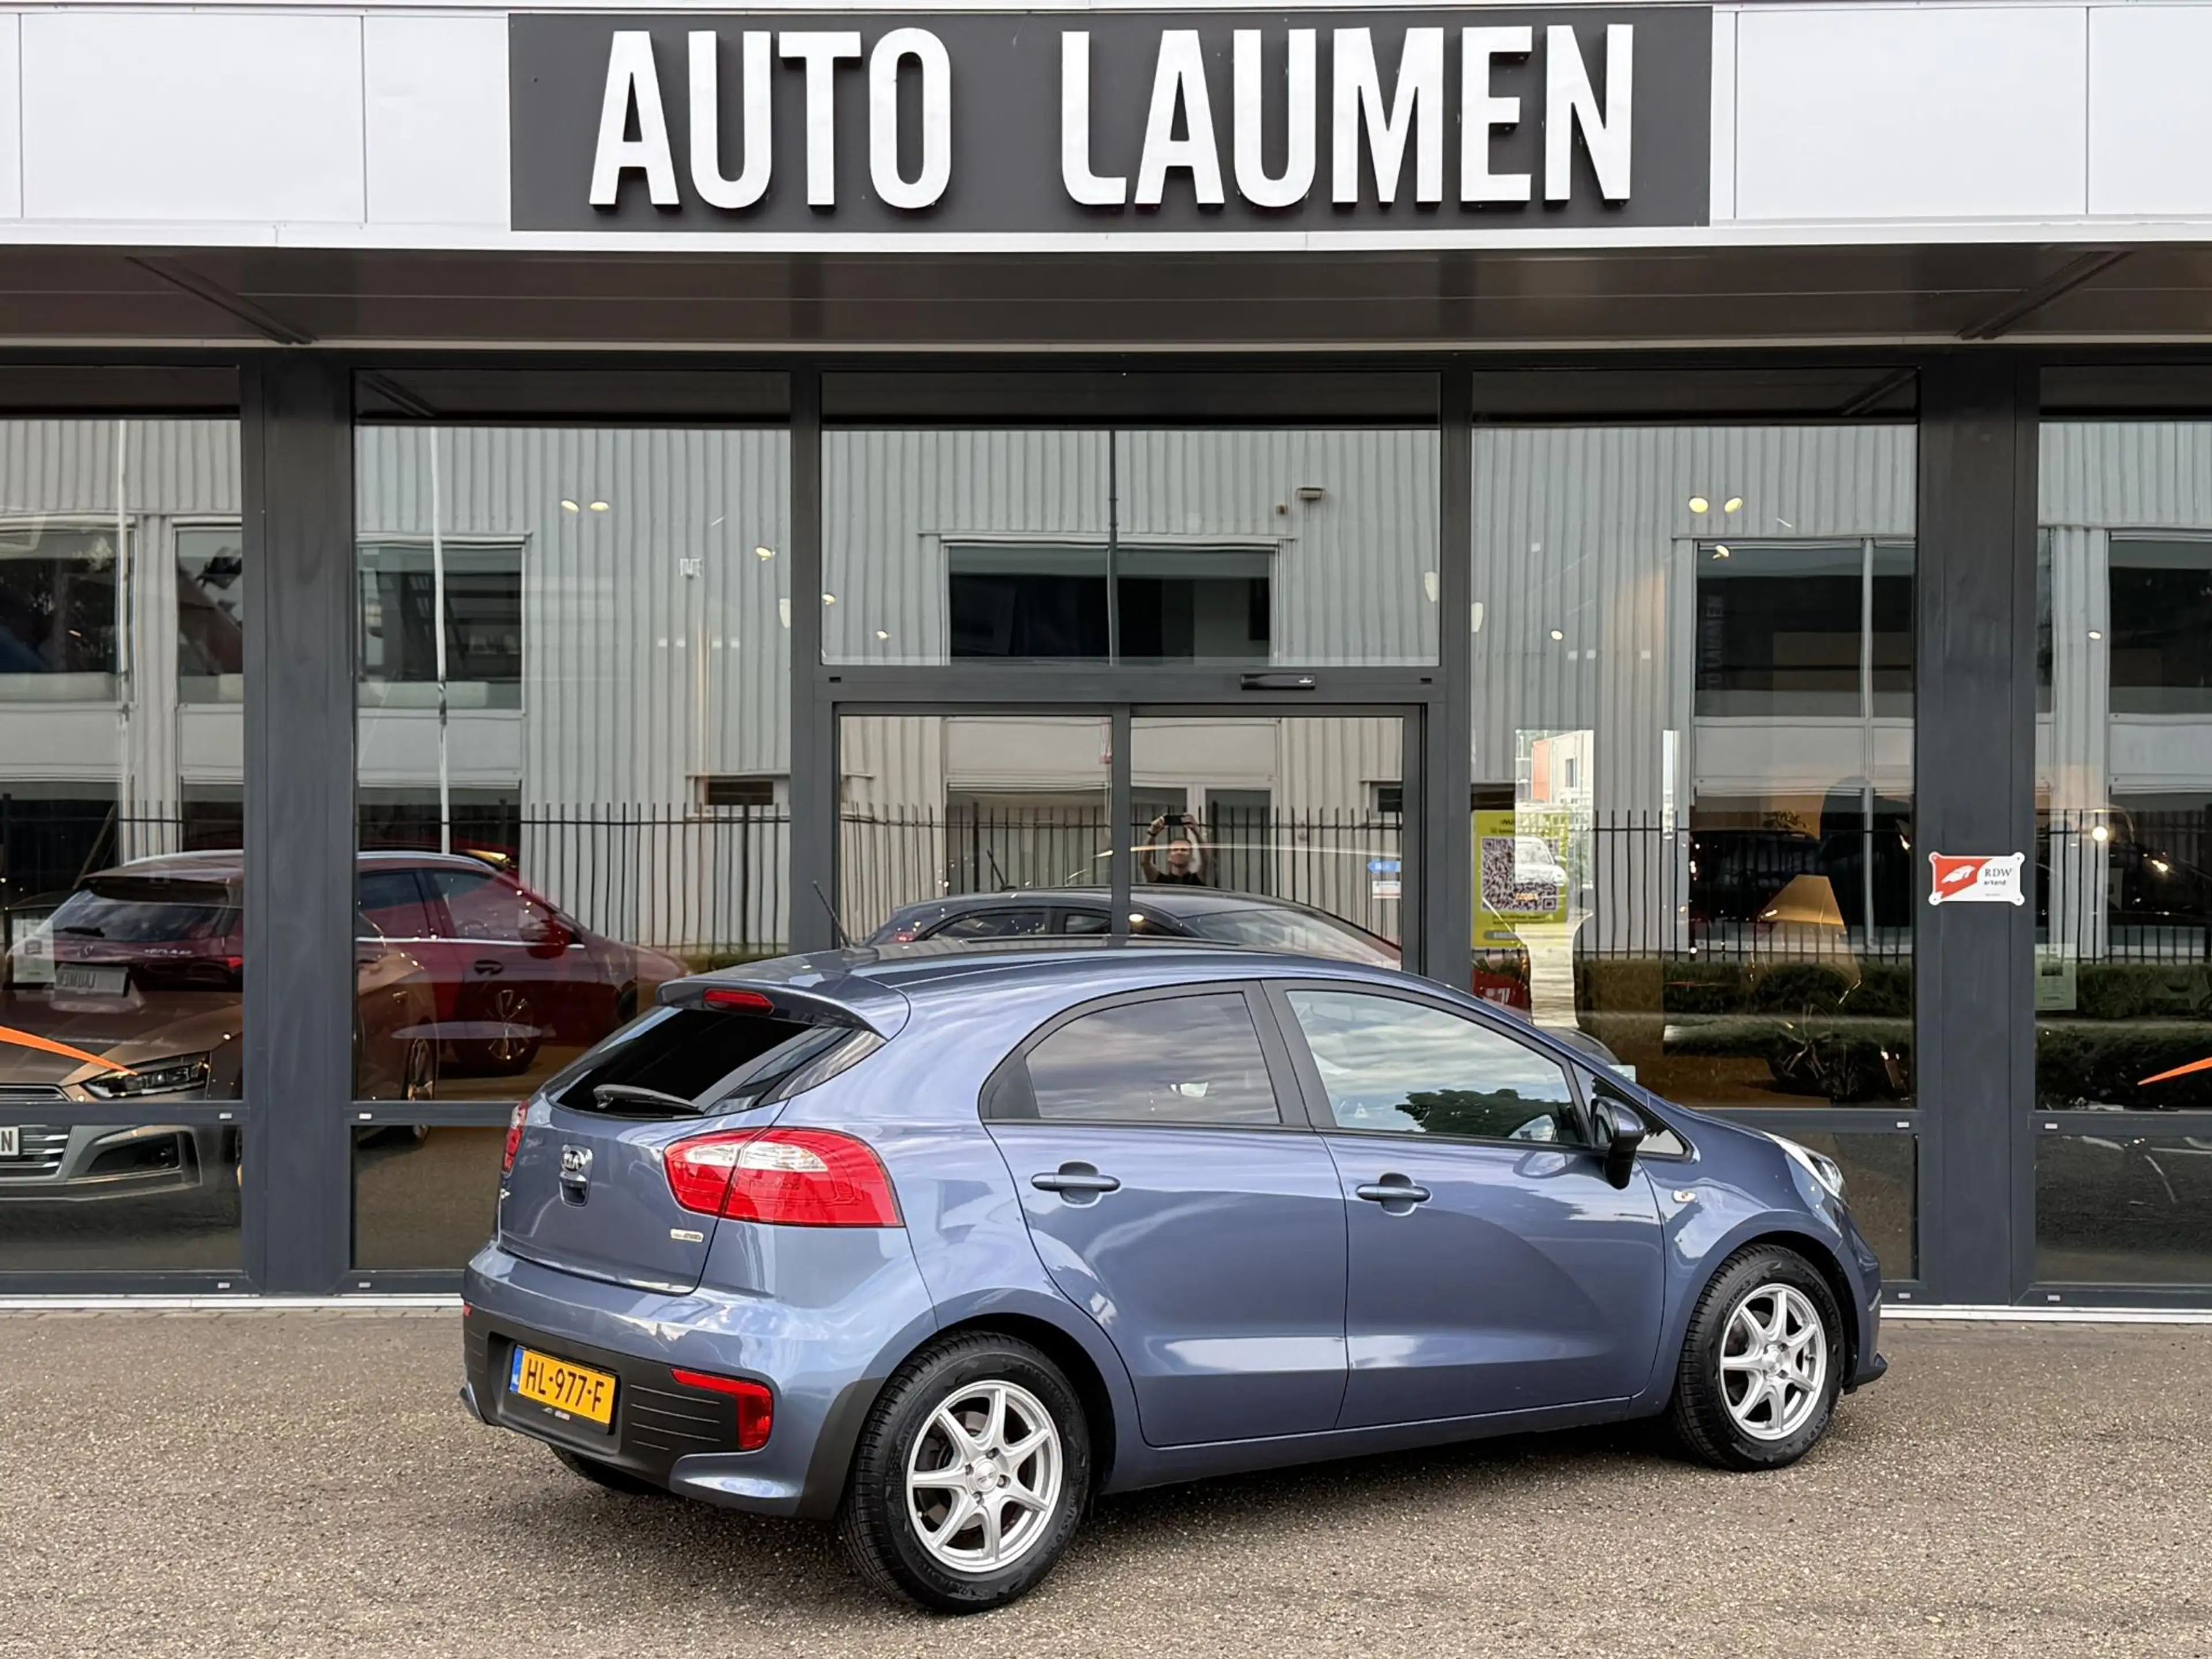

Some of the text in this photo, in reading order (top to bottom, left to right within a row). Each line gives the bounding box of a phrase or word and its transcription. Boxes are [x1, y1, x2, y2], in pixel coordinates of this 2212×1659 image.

[589, 24, 1633, 209] AUTO LAUMEN
[1984, 868, 2012, 877] RDW
[1, 1131, 13, 1152] N
